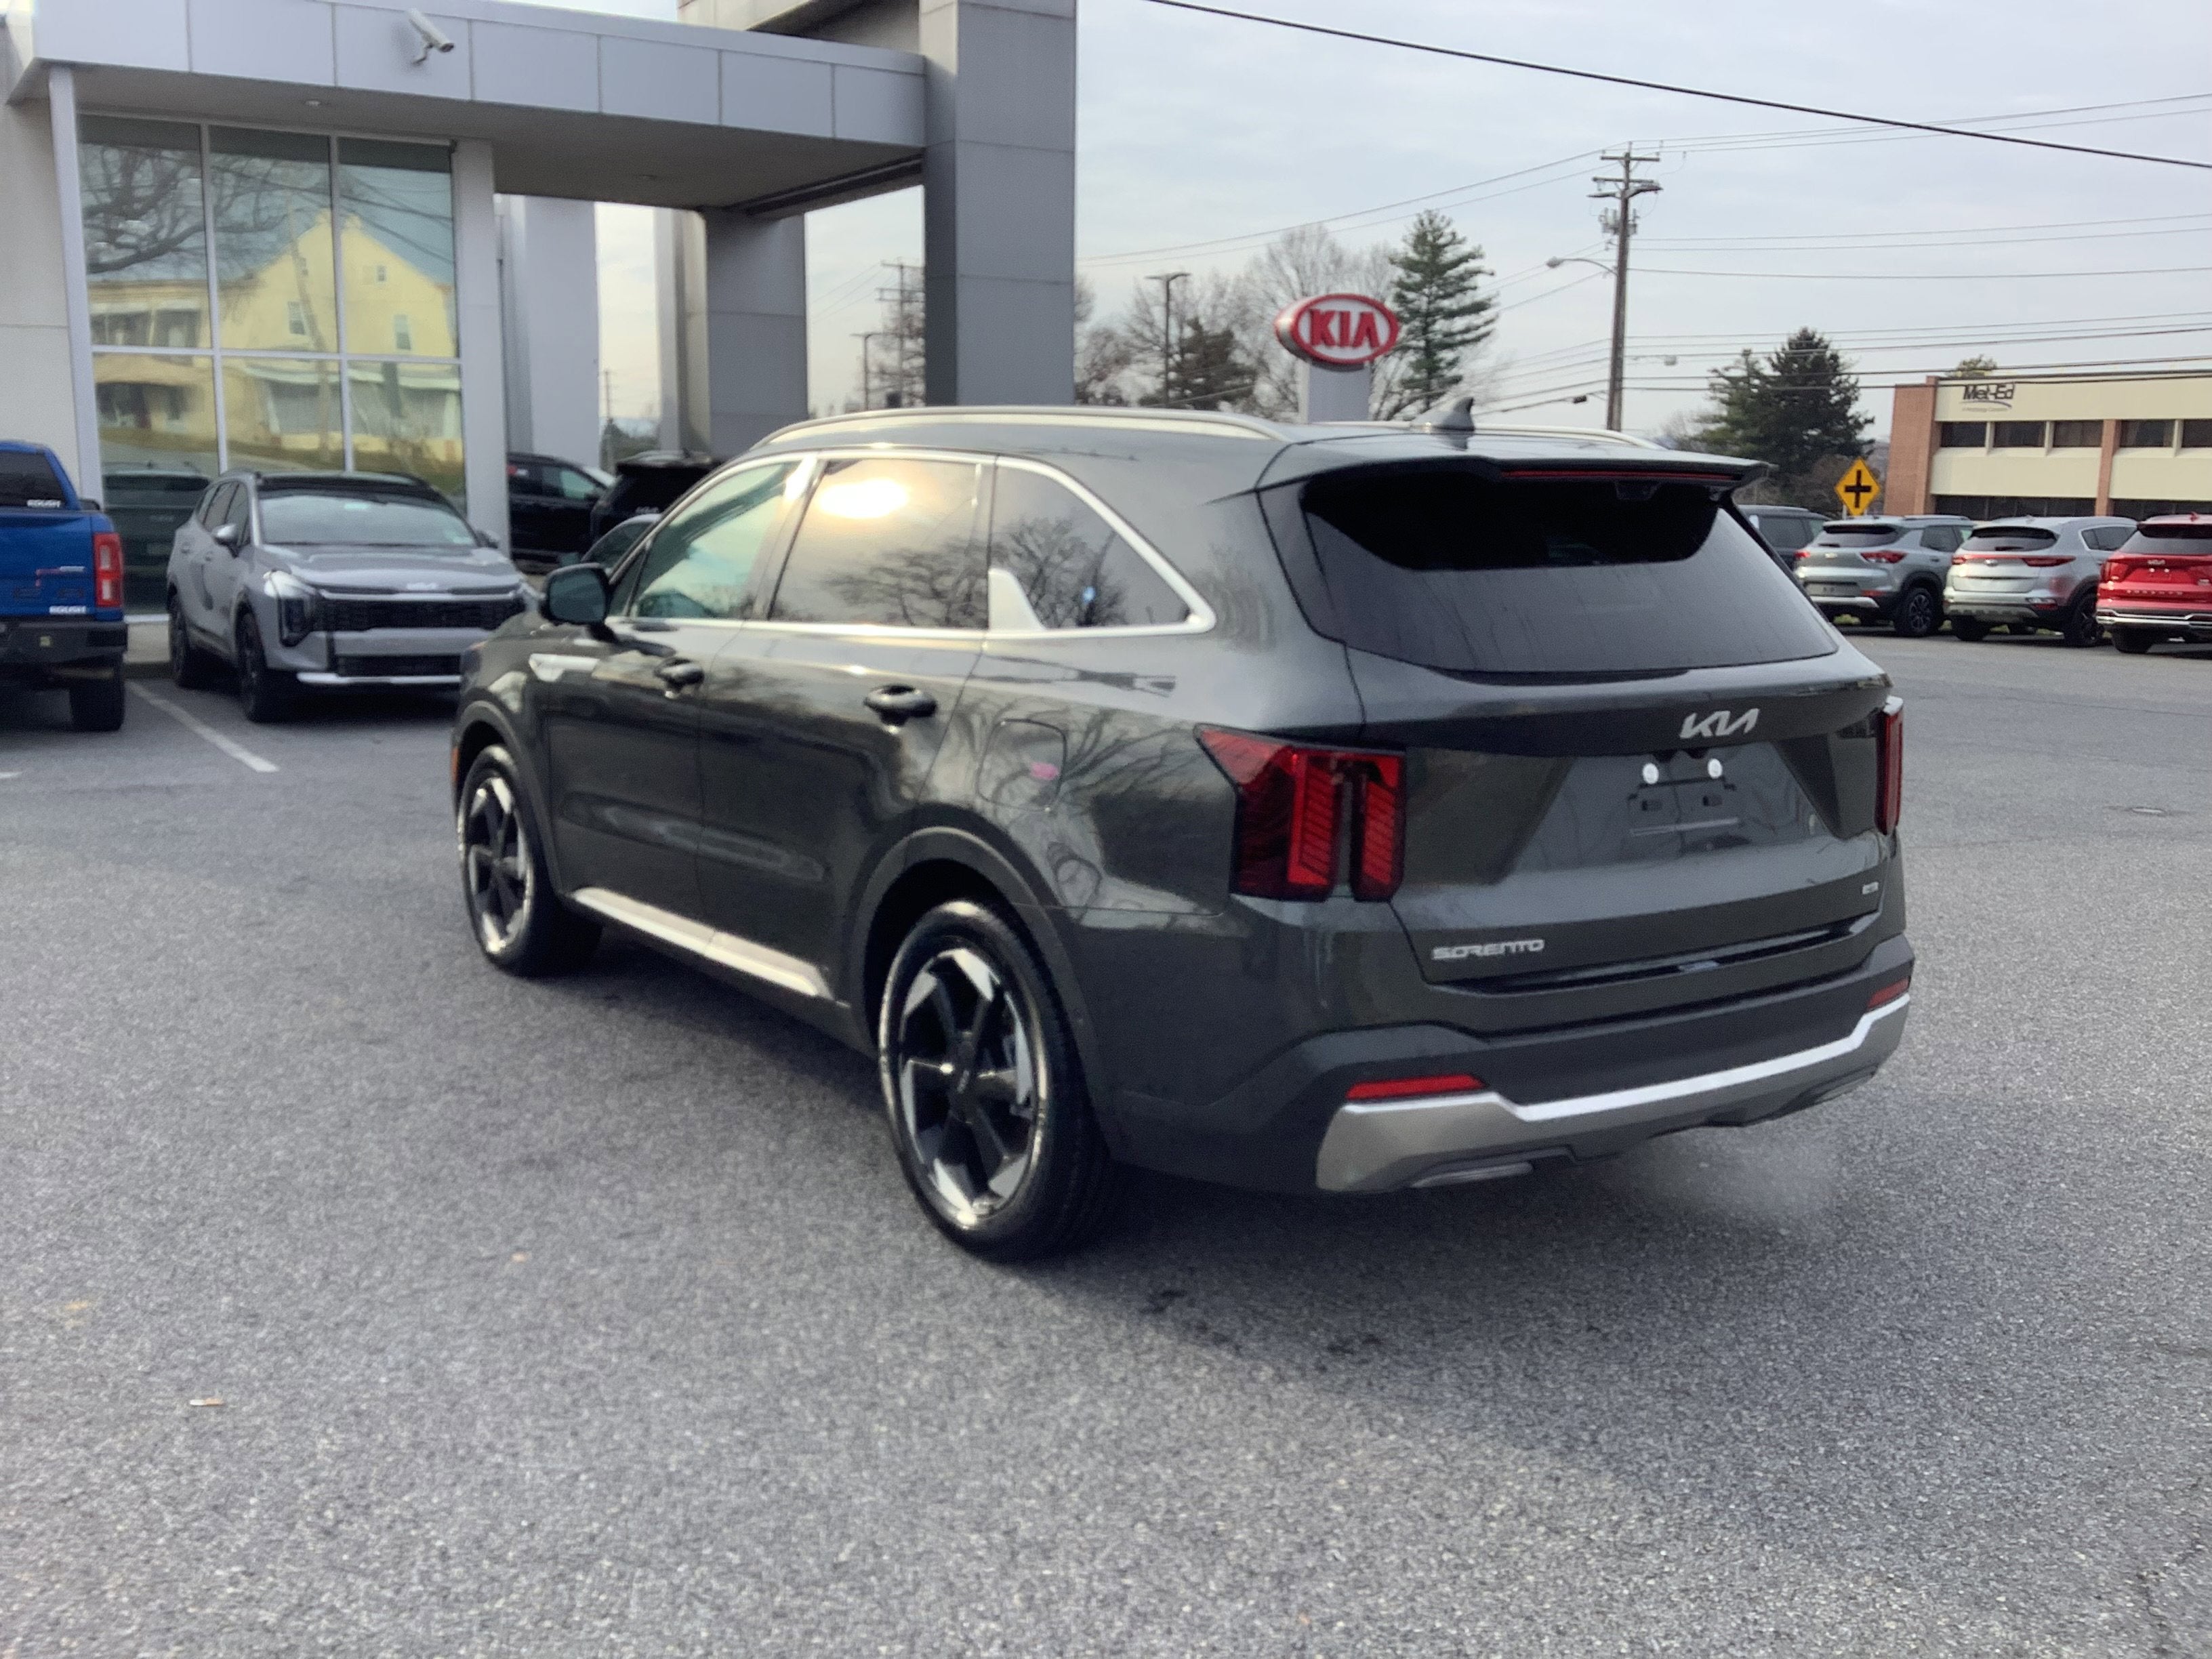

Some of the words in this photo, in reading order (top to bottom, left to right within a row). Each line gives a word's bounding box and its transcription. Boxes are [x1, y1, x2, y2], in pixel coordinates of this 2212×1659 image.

[1309, 308, 1380, 348] KIA
[1679, 708, 1760, 739] KIA
[1431, 939, 1546, 960] SORENTO
